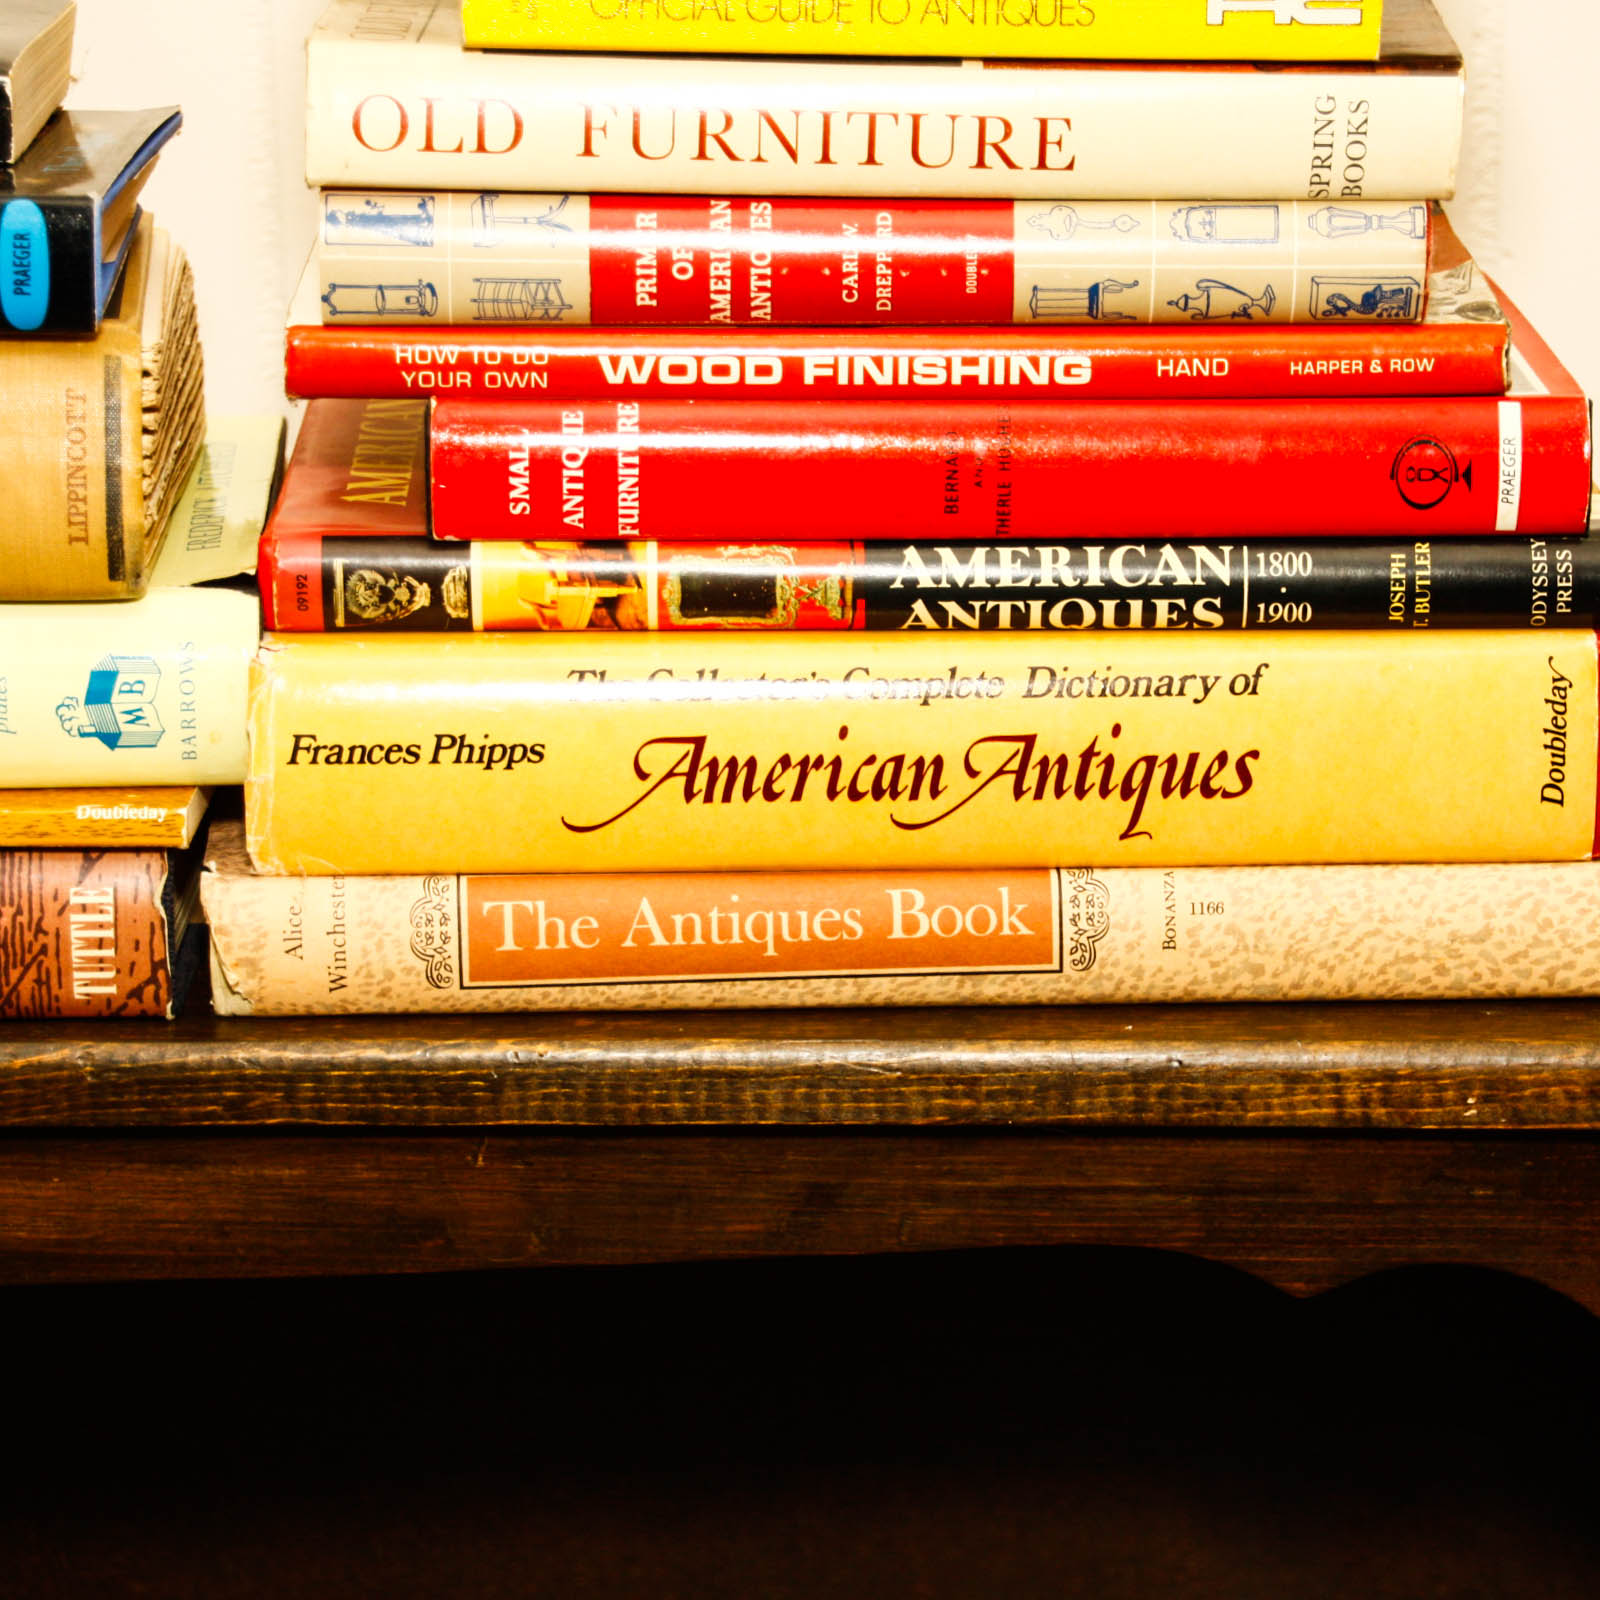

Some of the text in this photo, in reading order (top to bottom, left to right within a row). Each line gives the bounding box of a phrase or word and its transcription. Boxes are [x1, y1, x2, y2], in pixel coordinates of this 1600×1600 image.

[920, 0, 1097, 27] ANTIQUES
[351, 94, 1076, 172] OLD FURNITURE
[1308, 93, 1337, 199] SPRING
[1341, 98, 1371, 198] BOOKS
[13, 231, 32, 297] PRAEGER
[635, 211, 658, 308] PRIMR
[709, 199, 732, 324] AMERIAN
[750, 200, 773, 321] ANTIQES
[875, 211, 893, 312] DREPPRD
[965, 233, 979, 295] DOUBLEY
[394, 345, 550, 365] HOW TO DO
[401, 371, 548, 389] YOUR OWN
[598, 354, 1093, 386] WOOD FINISHING
[1157, 358, 1230, 377] HAND
[1290, 357, 1436, 375] HARPER & ROW
[65, 387, 88, 546] LIPPINCOTT
[617, 402, 640, 537] FURNITRE
[1500, 436, 1517, 505] PRAEGER
[996, 481, 1012, 537] THERLE
[296, 574, 309, 611] 09192
[889, 543, 1237, 589] AMERICAN
[1256, 551, 1313, 577] 1800
[1388, 552, 1407, 623] JOSEPH
[1413, 541, 1432, 614] BUTLER
[1530, 537, 1549, 627] ODYSSEY
[1555, 549, 1573, 613] PRESS
[900, 597, 1225, 630] ANTIQUES
[1256, 601, 1313, 624] 1900
[179, 641, 198, 761] BARROWS
[1022, 665, 1221, 704] Dictionary
[1229, 662, 1269, 697] of
[286, 733, 546, 770] Frances Phipps
[1541, 655, 1573, 807] Doubleday
[75, 803, 168, 822] Doubleday
[561, 722, 1261, 841] American Antiques
[282, 905, 304, 961] Alice
[325, 874, 349, 993] Winchester
[482, 886, 1035, 958] The Antiques Book
[1161, 870, 1177, 951] BONANZA
[1190, 901, 1225, 916] 1166
[69, 886, 118, 1000] TUTTLE
